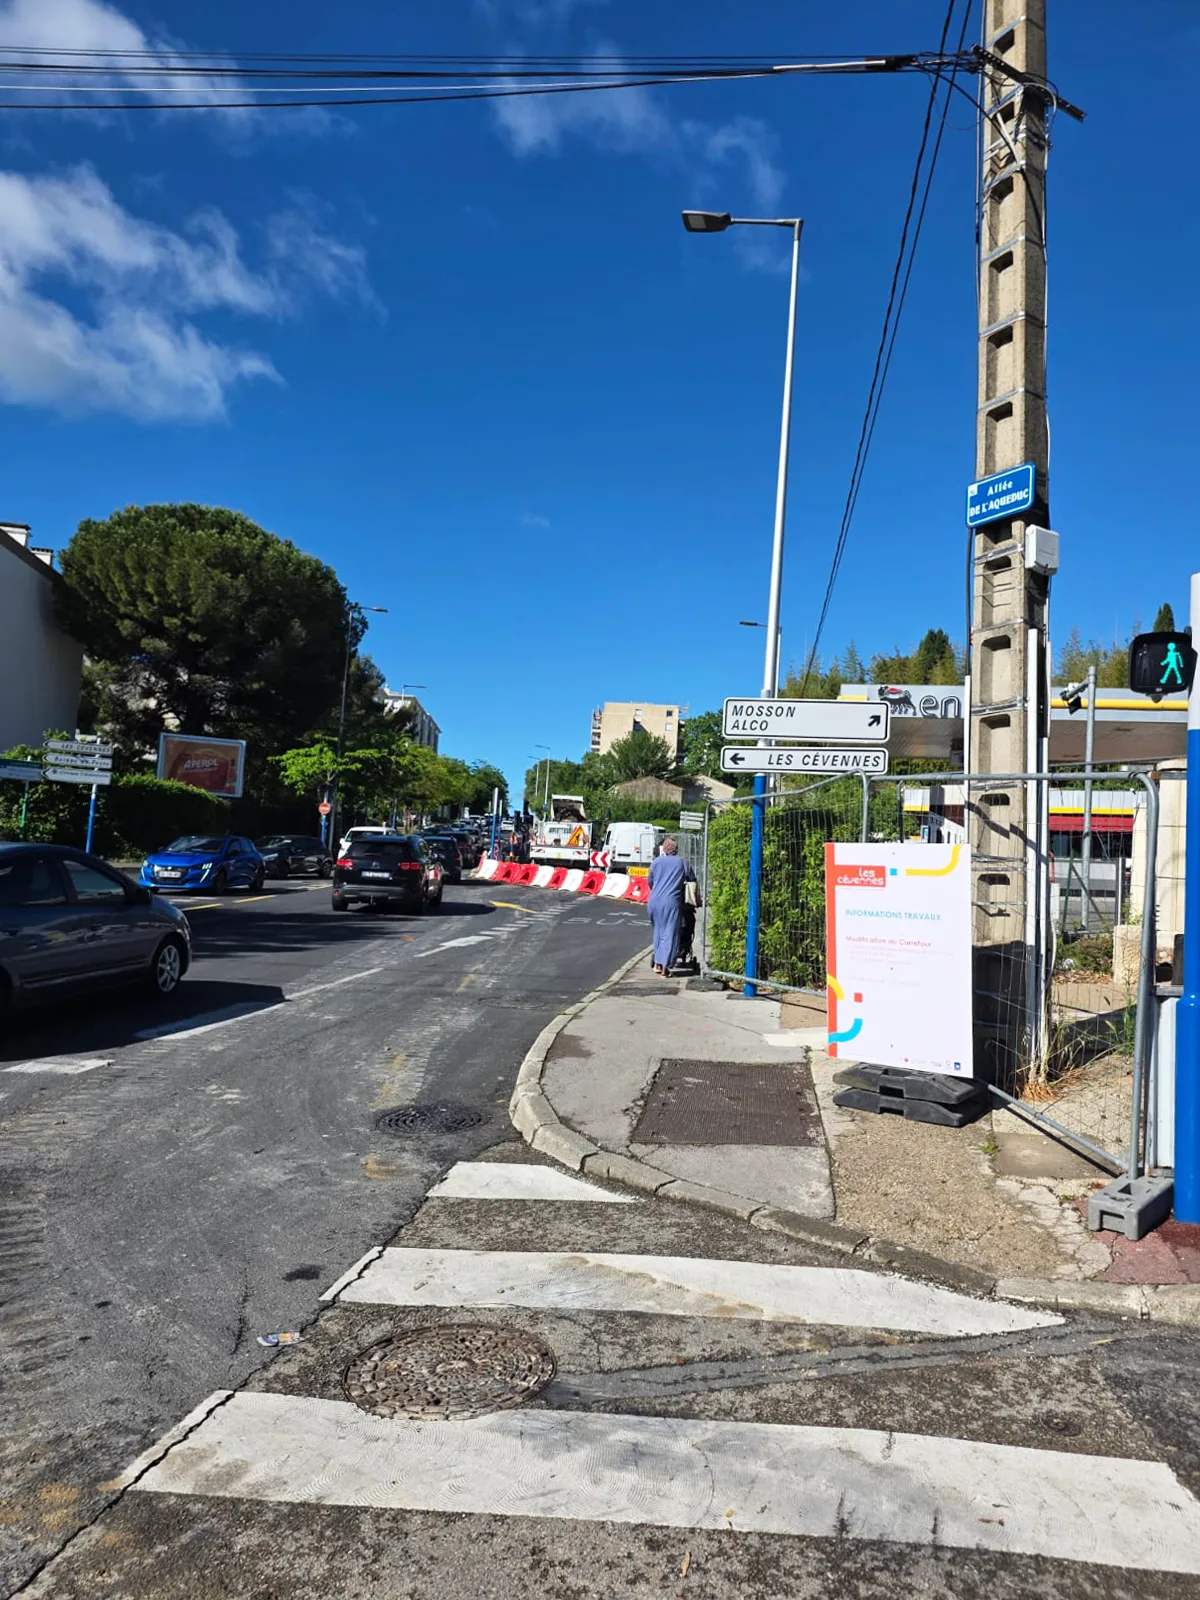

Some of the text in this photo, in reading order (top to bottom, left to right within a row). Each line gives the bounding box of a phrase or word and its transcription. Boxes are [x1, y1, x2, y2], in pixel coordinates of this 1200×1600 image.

[987, 480, 1013, 496] Allée
[969, 489, 1029, 517] DE L'AQUEDUC
[731, 704, 797, 718] MOSSON
[919, 694, 962, 718] en
[731, 719, 769, 731] ALCO
[184, 759, 219, 770] APEROL
[767, 751, 881, 768] LES CÉVENNES
[858, 867, 876, 877] les
[837, 874, 884, 885] cévennes
[845, 908, 942, 921] INFORMATIONS TRAVAUX
[845, 936, 887, 944] Modification
[898, 939, 932, 947] Carrefour
